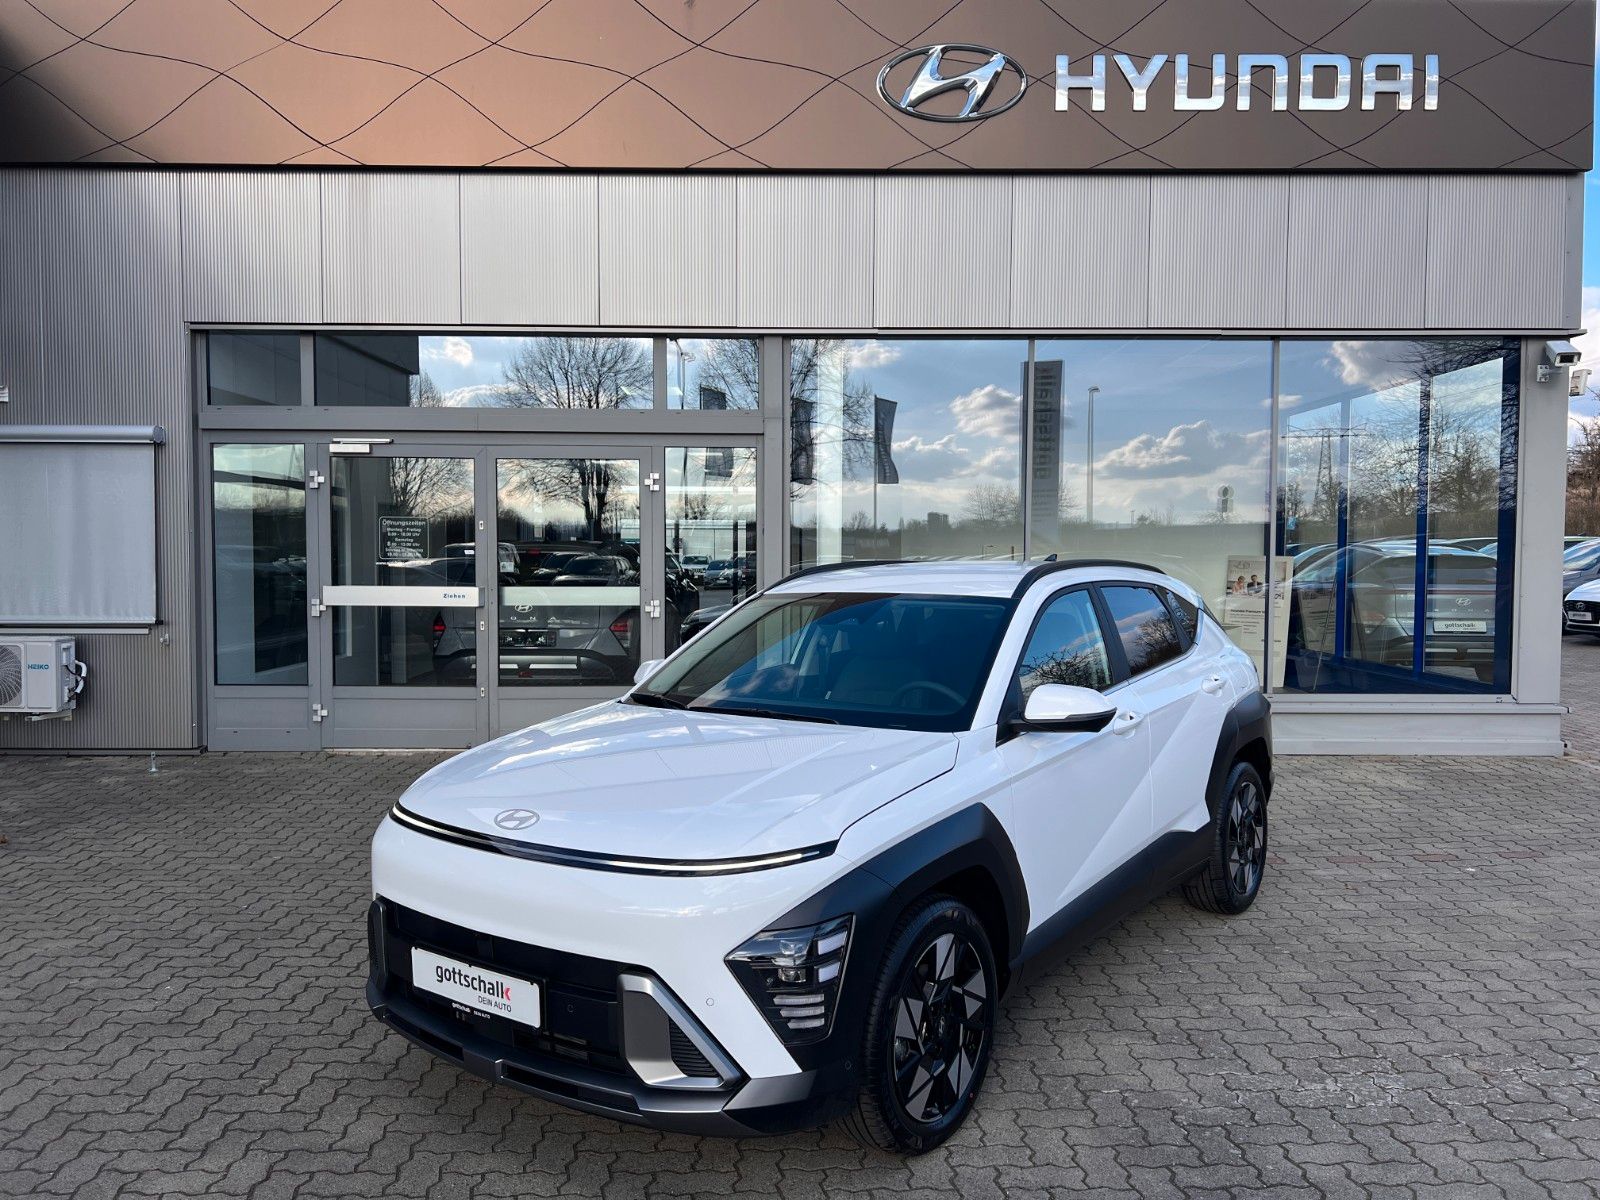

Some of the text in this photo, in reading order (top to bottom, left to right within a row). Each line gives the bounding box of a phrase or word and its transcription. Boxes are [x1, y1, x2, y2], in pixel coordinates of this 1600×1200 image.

[1054, 54, 1439, 111] HYUNDAI
[435, 965, 511, 1001] gottschalk
[478, 995, 512, 1013] DEIN AUTO
